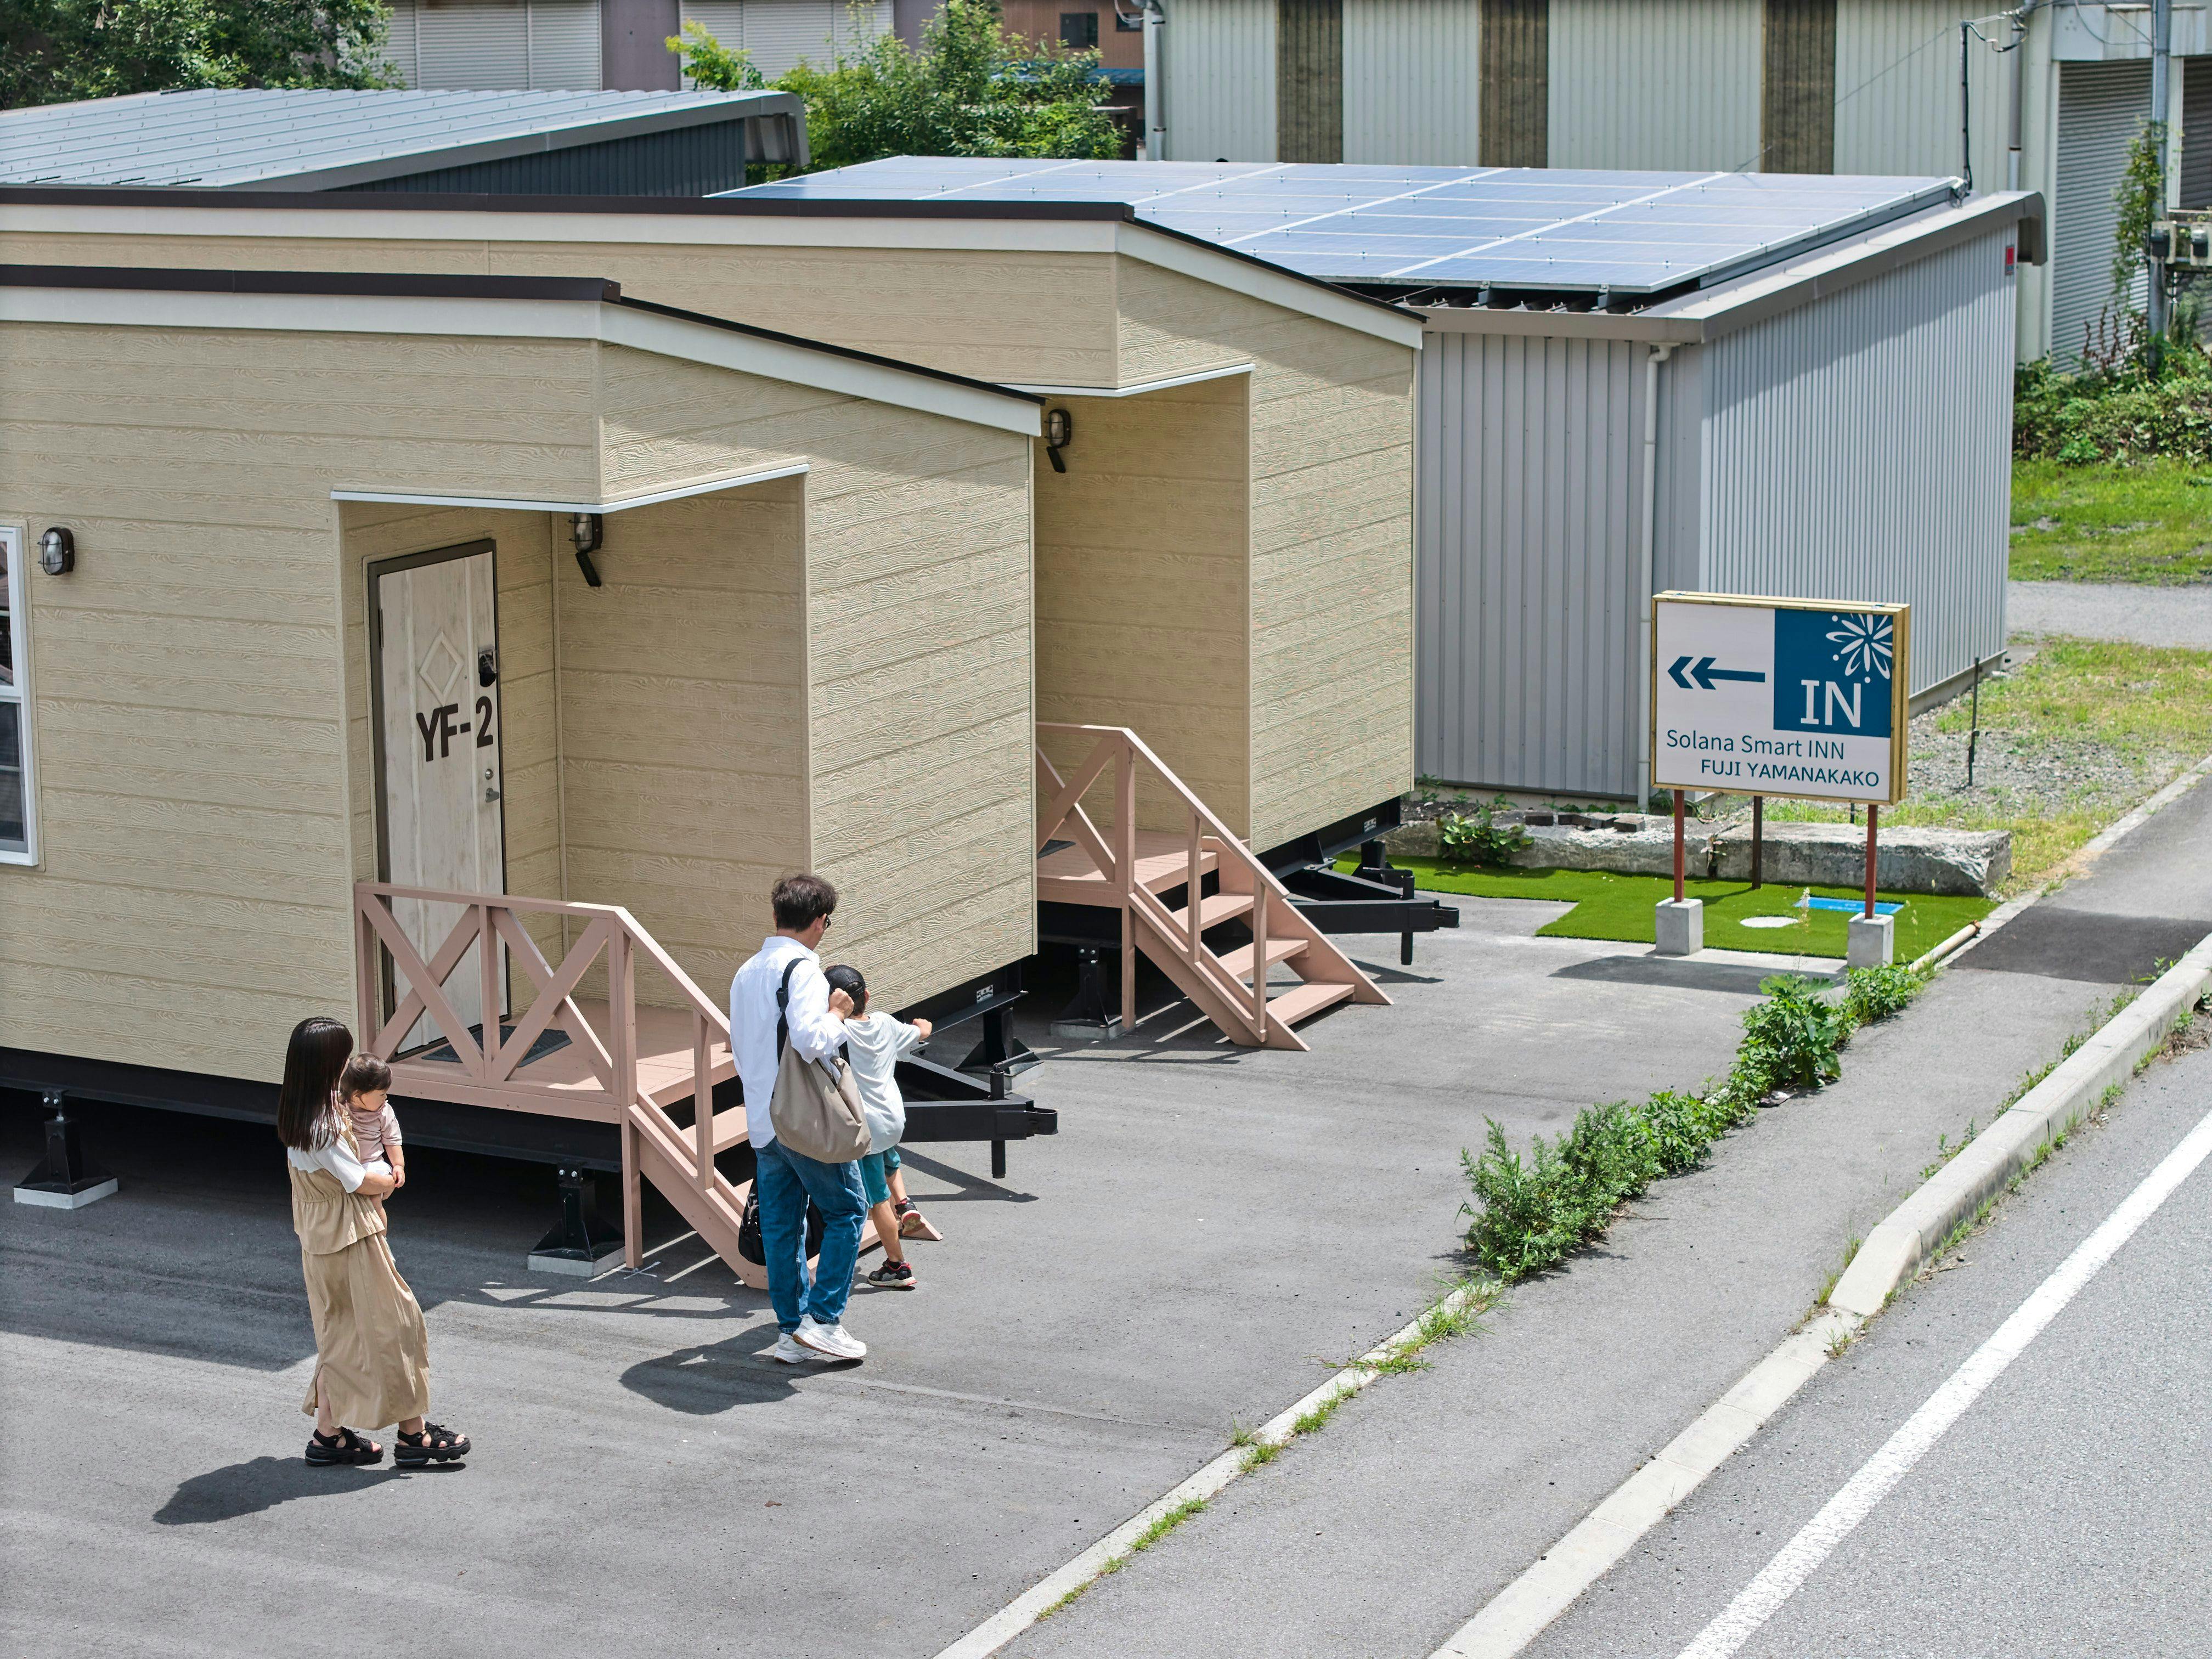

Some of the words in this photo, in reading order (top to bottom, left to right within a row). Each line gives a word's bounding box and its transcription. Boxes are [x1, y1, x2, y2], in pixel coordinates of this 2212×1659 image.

[1801, 679, 1861, 728] IN
[416, 696, 494, 762] YF-2
[1667, 729, 1734, 752] Solana
[1741, 735, 1802, 757] Smart
[1809, 740, 1844, 760] INN
[1701, 759, 1741, 776] FUJI
[1747, 763, 1880, 787] YAMANAKAKO
